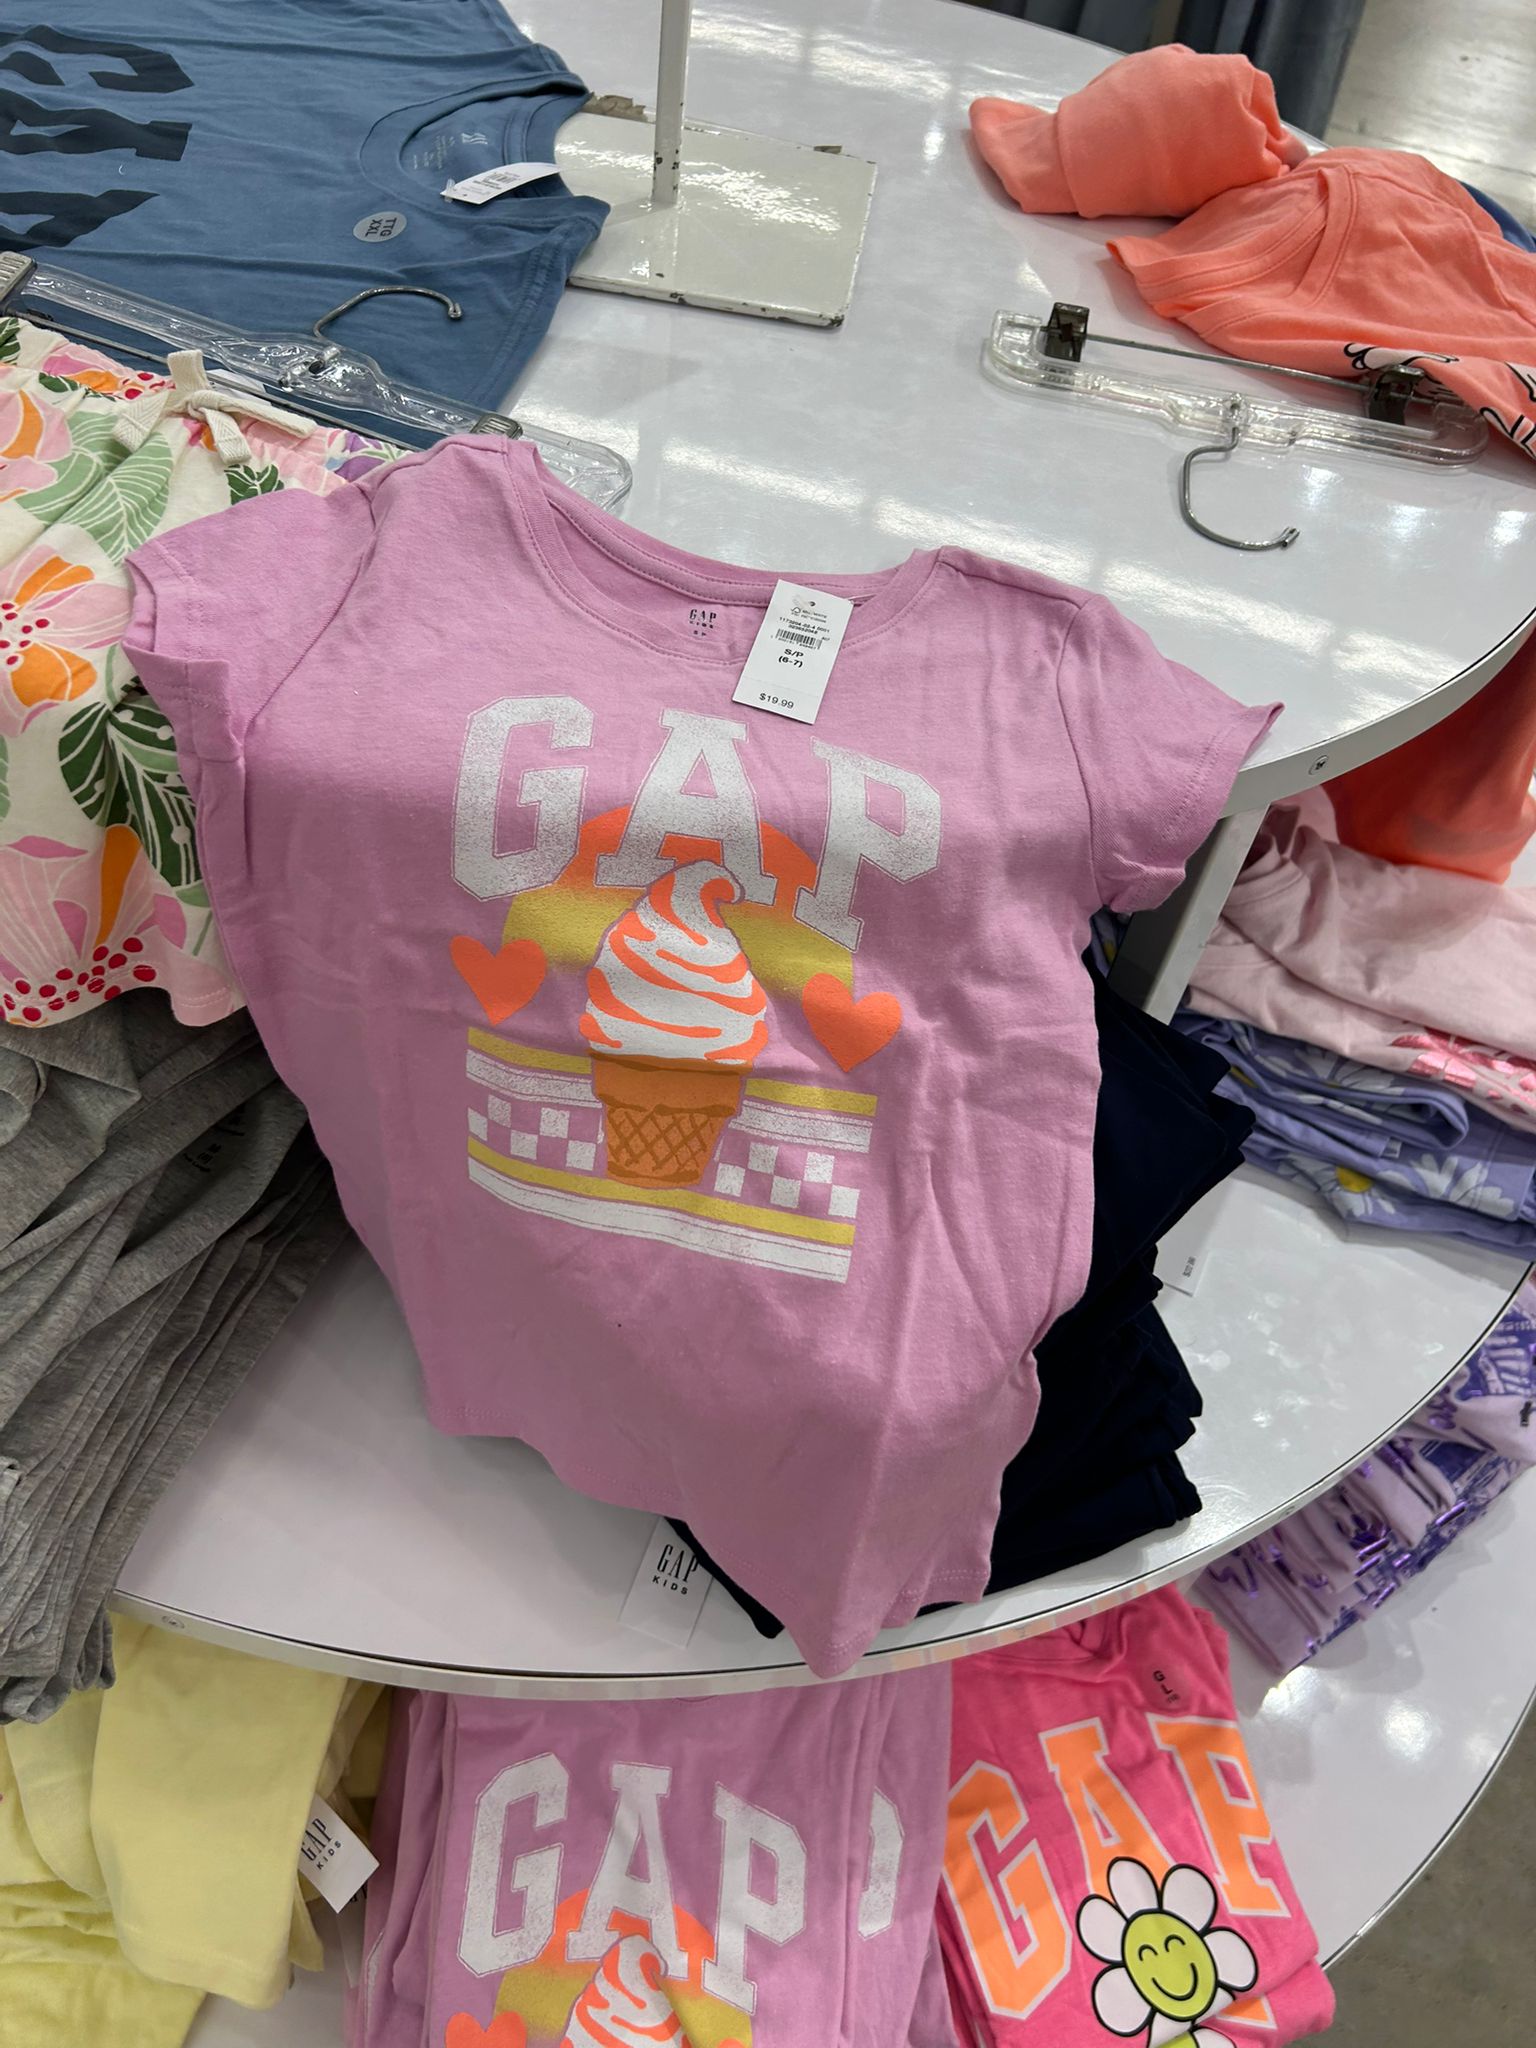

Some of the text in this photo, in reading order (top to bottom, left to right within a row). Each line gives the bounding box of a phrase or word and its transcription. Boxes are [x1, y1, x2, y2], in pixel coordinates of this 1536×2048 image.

[365, 218, 383, 238] XXL
[380, 217, 397, 238] TTG
[688, 608, 717, 623] GAP
[778, 656, 803, 668] (6-7)
[783, 648, 804, 658] S/P
[759, 692, 794, 709] $19.99
[450, 694, 943, 954] GAP
[656, 1543, 700, 1583] GAP
[652, 1575, 689, 1595] KIDS
[1153, 1670, 1166, 1682] G
[1160, 1683, 1173, 1695] L
[300, 1818, 332, 1862] GAP
[316, 1840, 342, 1870] KIDS
[942, 1715, 1291, 2020] GAP
[456, 1751, 808, 2016] GAP
